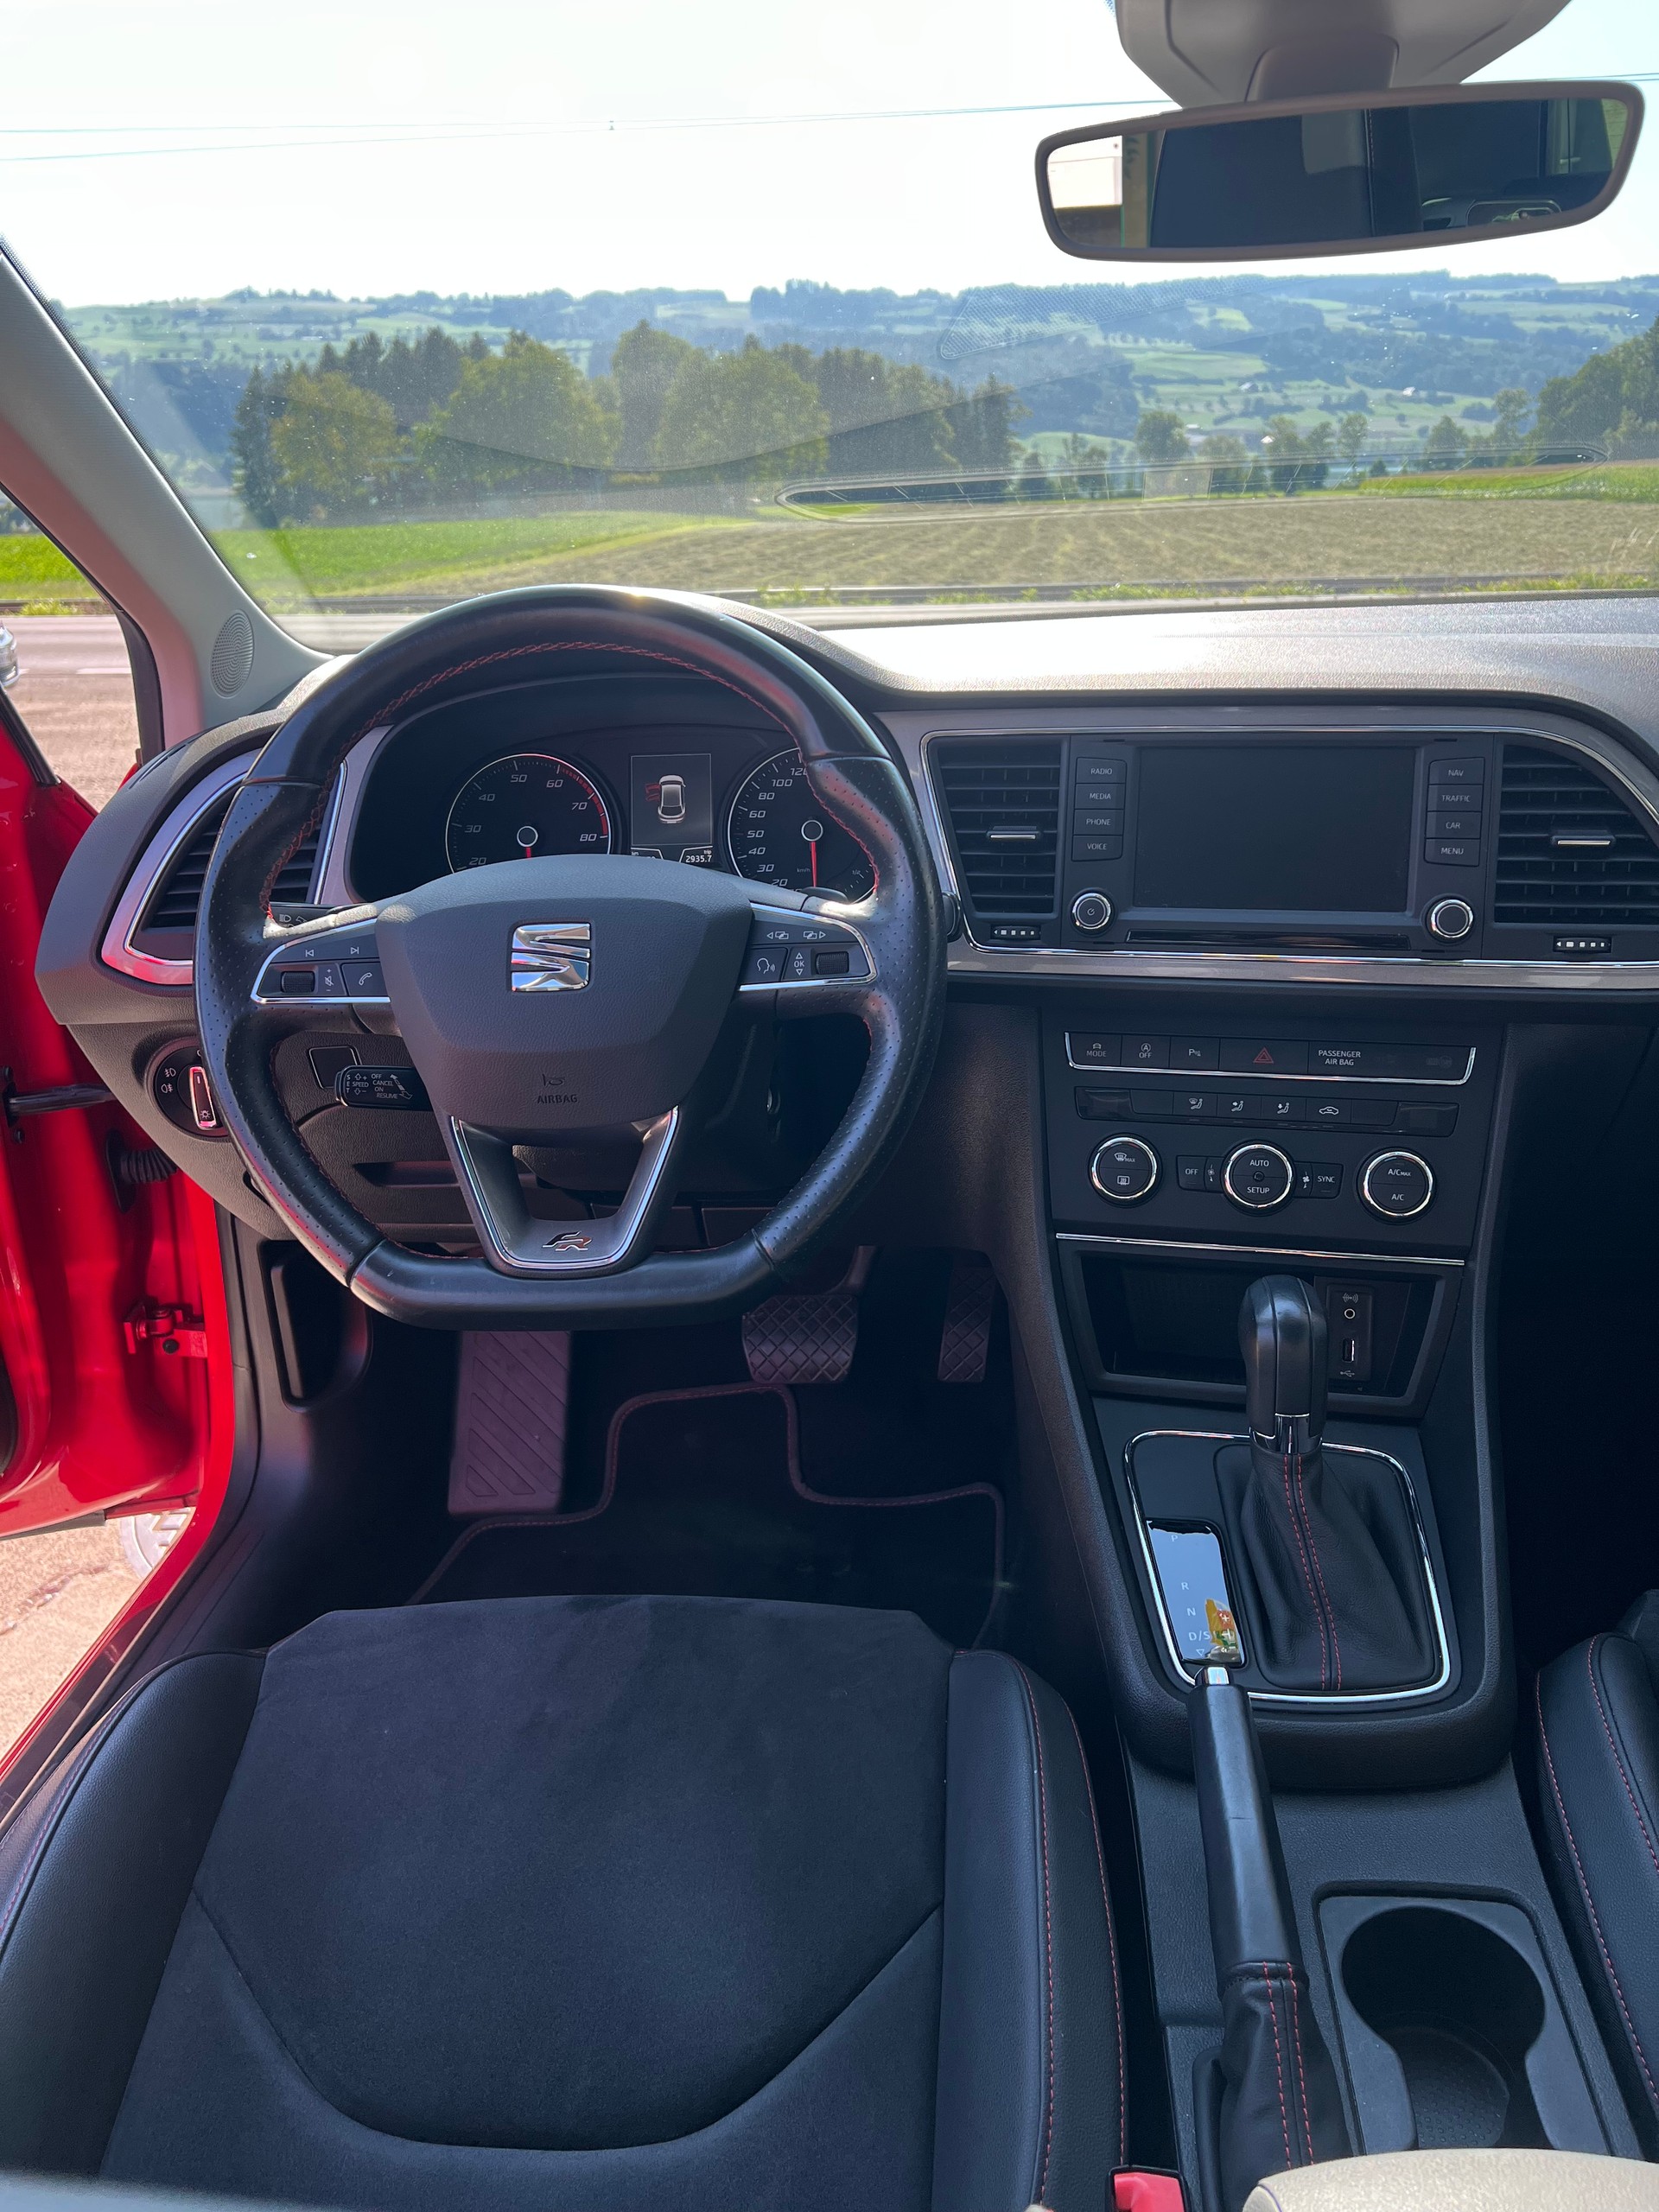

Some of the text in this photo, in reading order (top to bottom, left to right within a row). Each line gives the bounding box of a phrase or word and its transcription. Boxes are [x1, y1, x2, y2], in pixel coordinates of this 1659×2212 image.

[510, 774, 528, 783] 50
[772, 779, 793, 787] 100
[545, 779, 564, 788] 60
[478, 793, 496, 802] 40
[1441, 794, 1471, 803] TRAFFIC
[571, 802, 588, 810] 70
[464, 824, 482, 833] 30
[579, 833, 597, 842] 80
[748, 847, 766, 855] 40
[468, 857, 487, 866] 20
[685, 855, 713, 863] 2935.7
[757, 864, 775, 873] 30
[1318, 1049, 1362, 1058] PASSENGER
[537, 1094, 578, 1104] AIRBAG
[1249, 1159, 1270, 1167] AUTO
[1185, 1167, 1199, 1176] OFF
[1317, 1175, 1336, 1184] SYNC
[1246, 1186, 1270, 1195] SETUP
[1181, 1582, 1190, 1591] R
[1186, 1607, 1197, 1617] N
[1188, 1630, 1211, 1642] D/S
